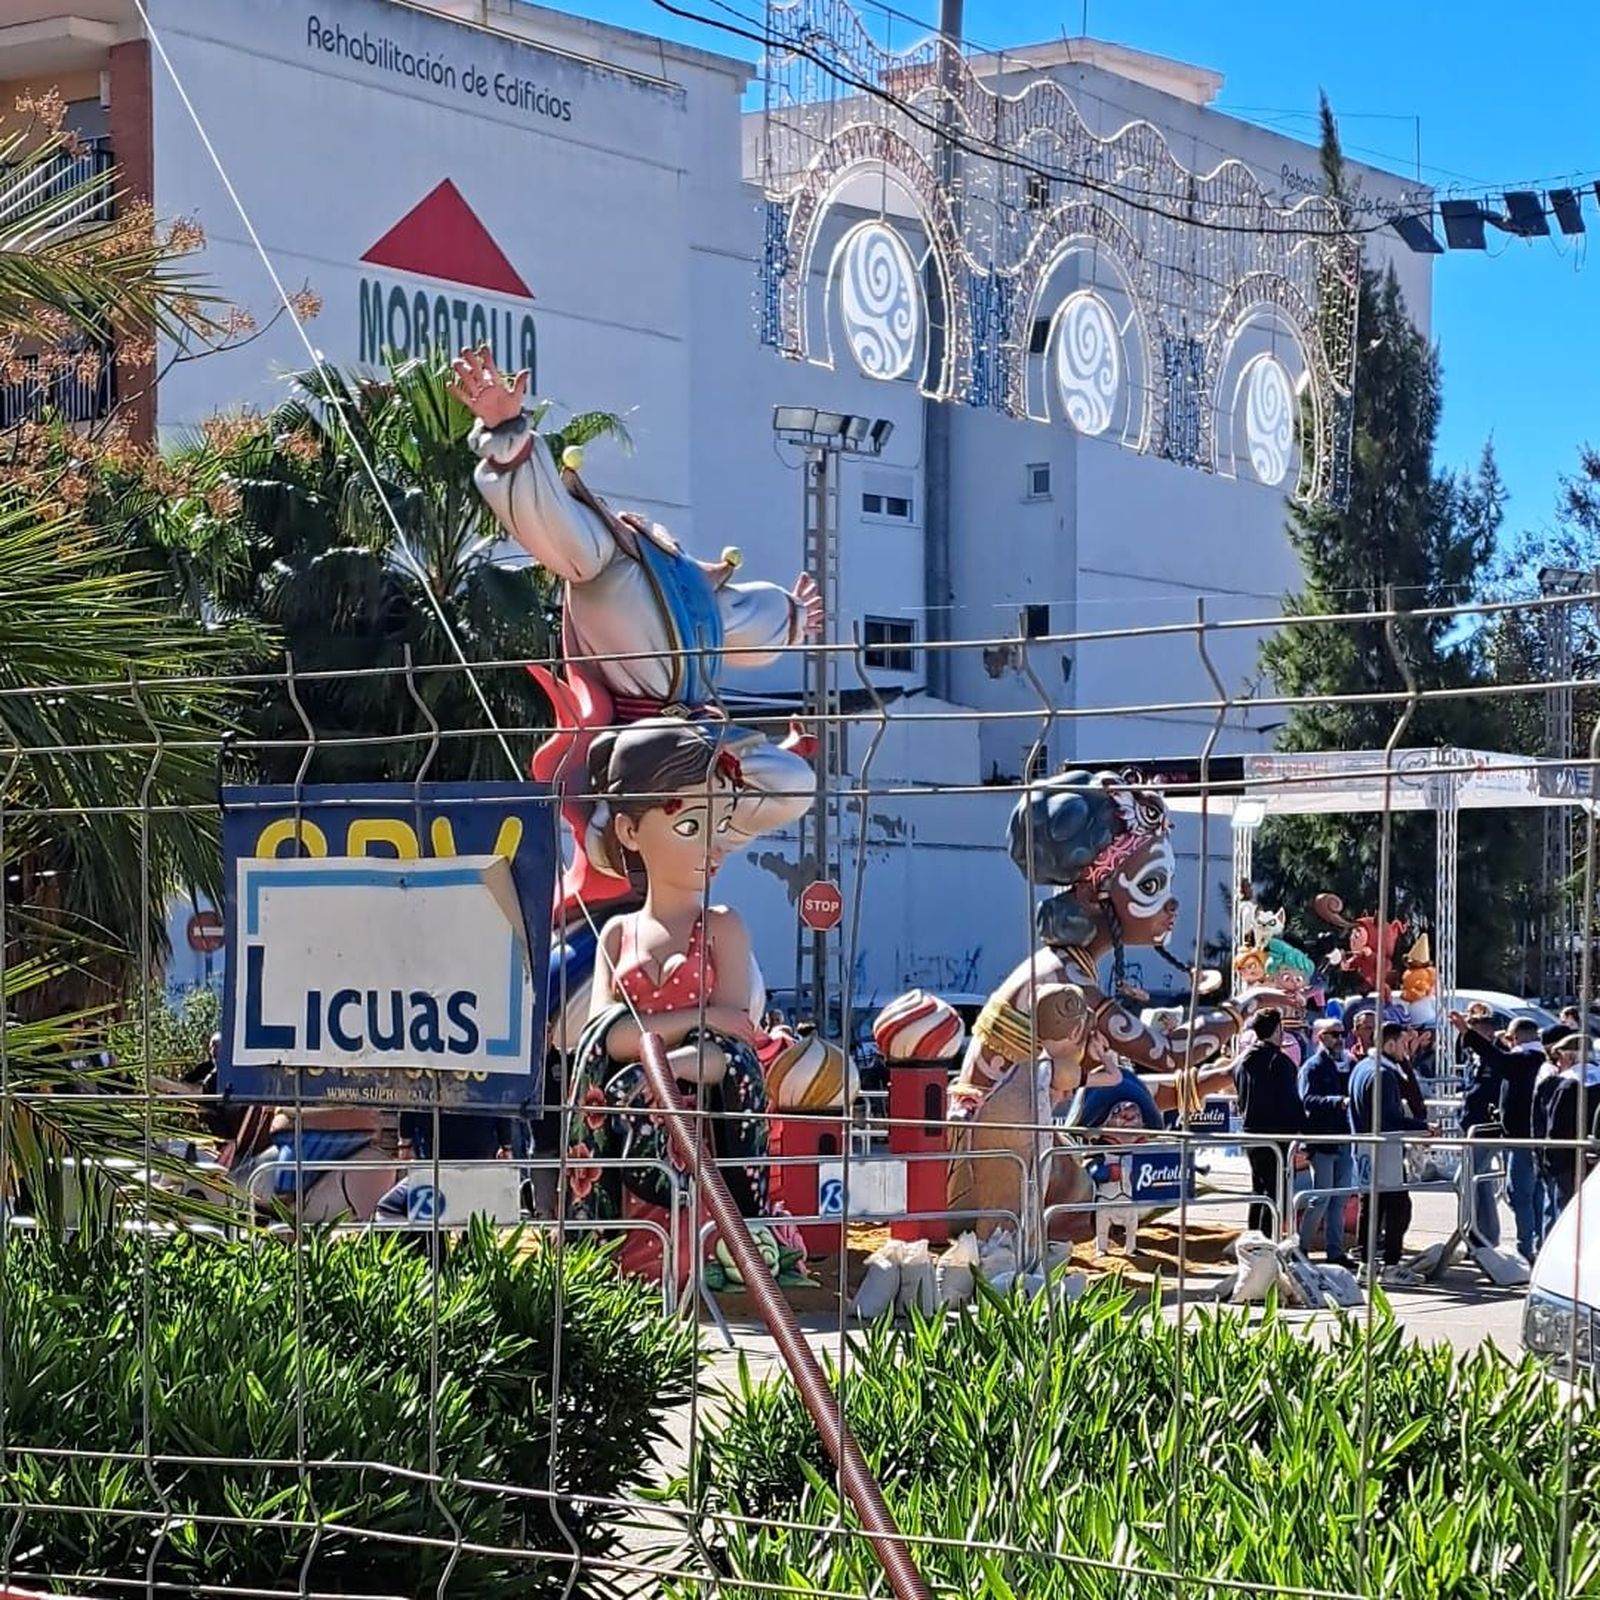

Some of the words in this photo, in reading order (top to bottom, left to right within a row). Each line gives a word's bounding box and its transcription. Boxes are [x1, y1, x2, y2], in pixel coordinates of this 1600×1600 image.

[308, 15, 456, 90] Rehabilitación
[462, 64, 488, 97] de
[494, 73, 572, 121] Edificios
[804, 898, 839, 912] STOP
[245, 945, 480, 1055] Licuas
